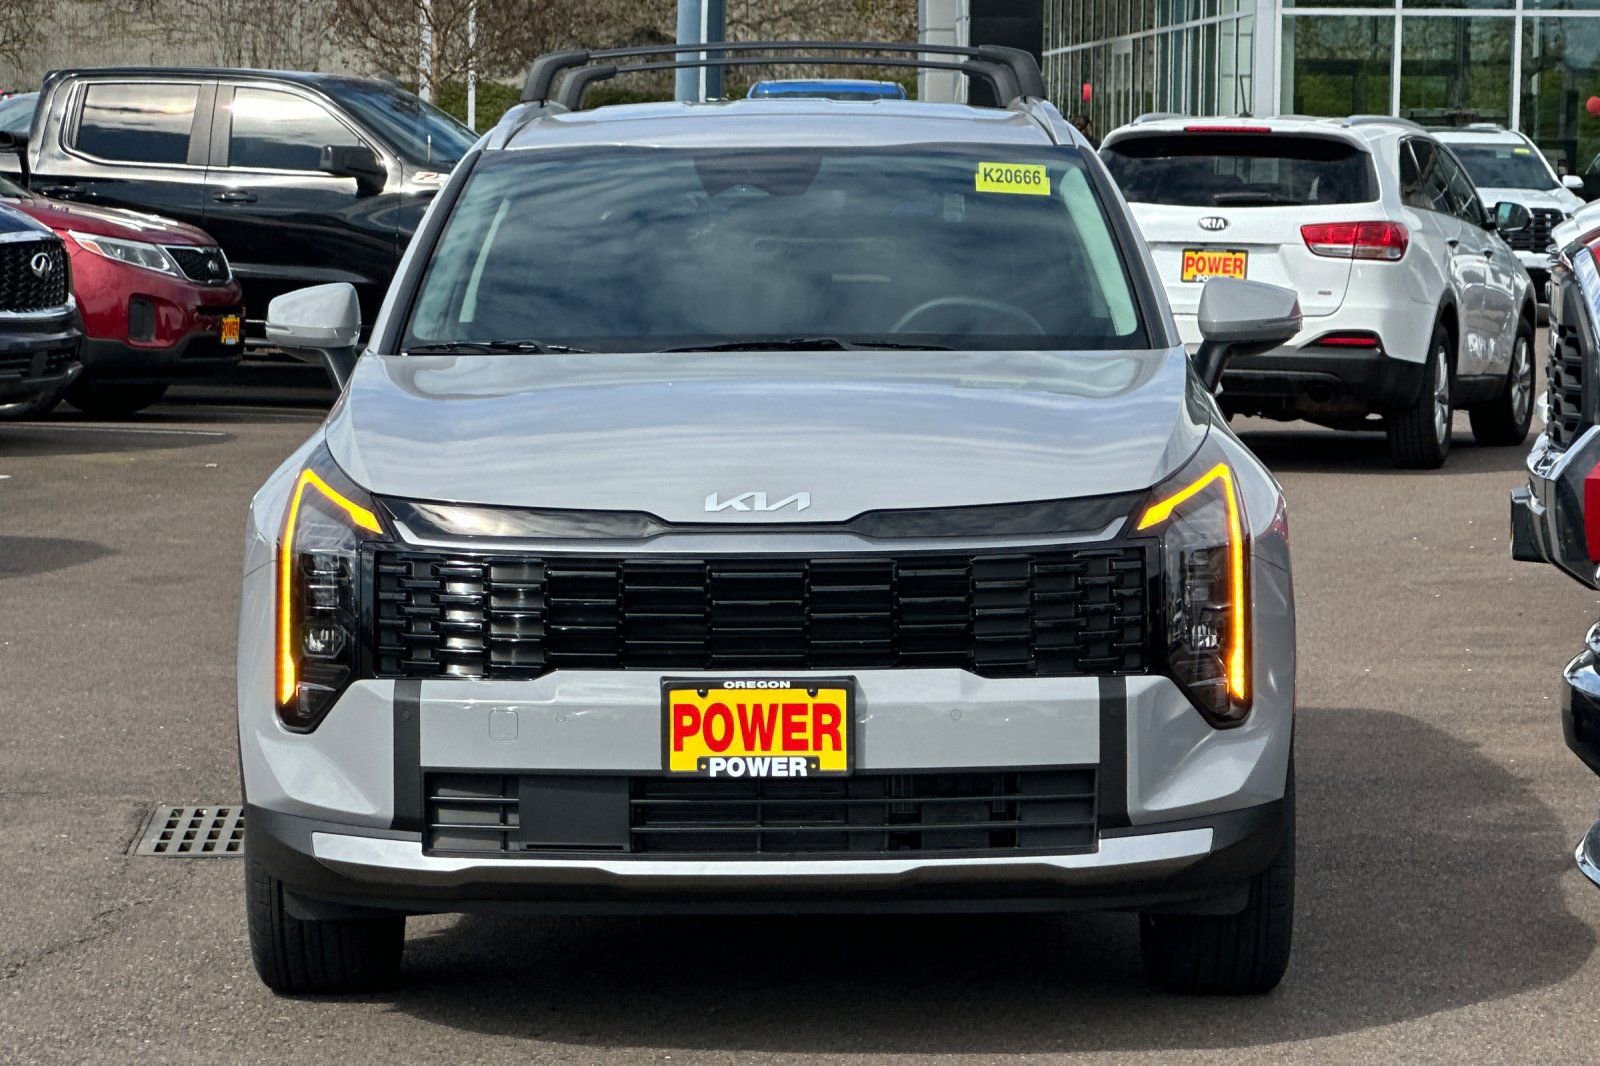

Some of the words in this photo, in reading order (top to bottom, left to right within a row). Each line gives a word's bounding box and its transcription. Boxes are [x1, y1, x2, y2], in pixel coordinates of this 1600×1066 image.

[983, 167, 1042, 185] K20666
[1200, 218, 1225, 229] KIA
[1185, 255, 1244, 275] POWER
[704, 491, 811, 512] KIA
[723, 680, 791, 689] OREGON
[673, 702, 842, 753] POWER
[709, 757, 807, 778] POWER
